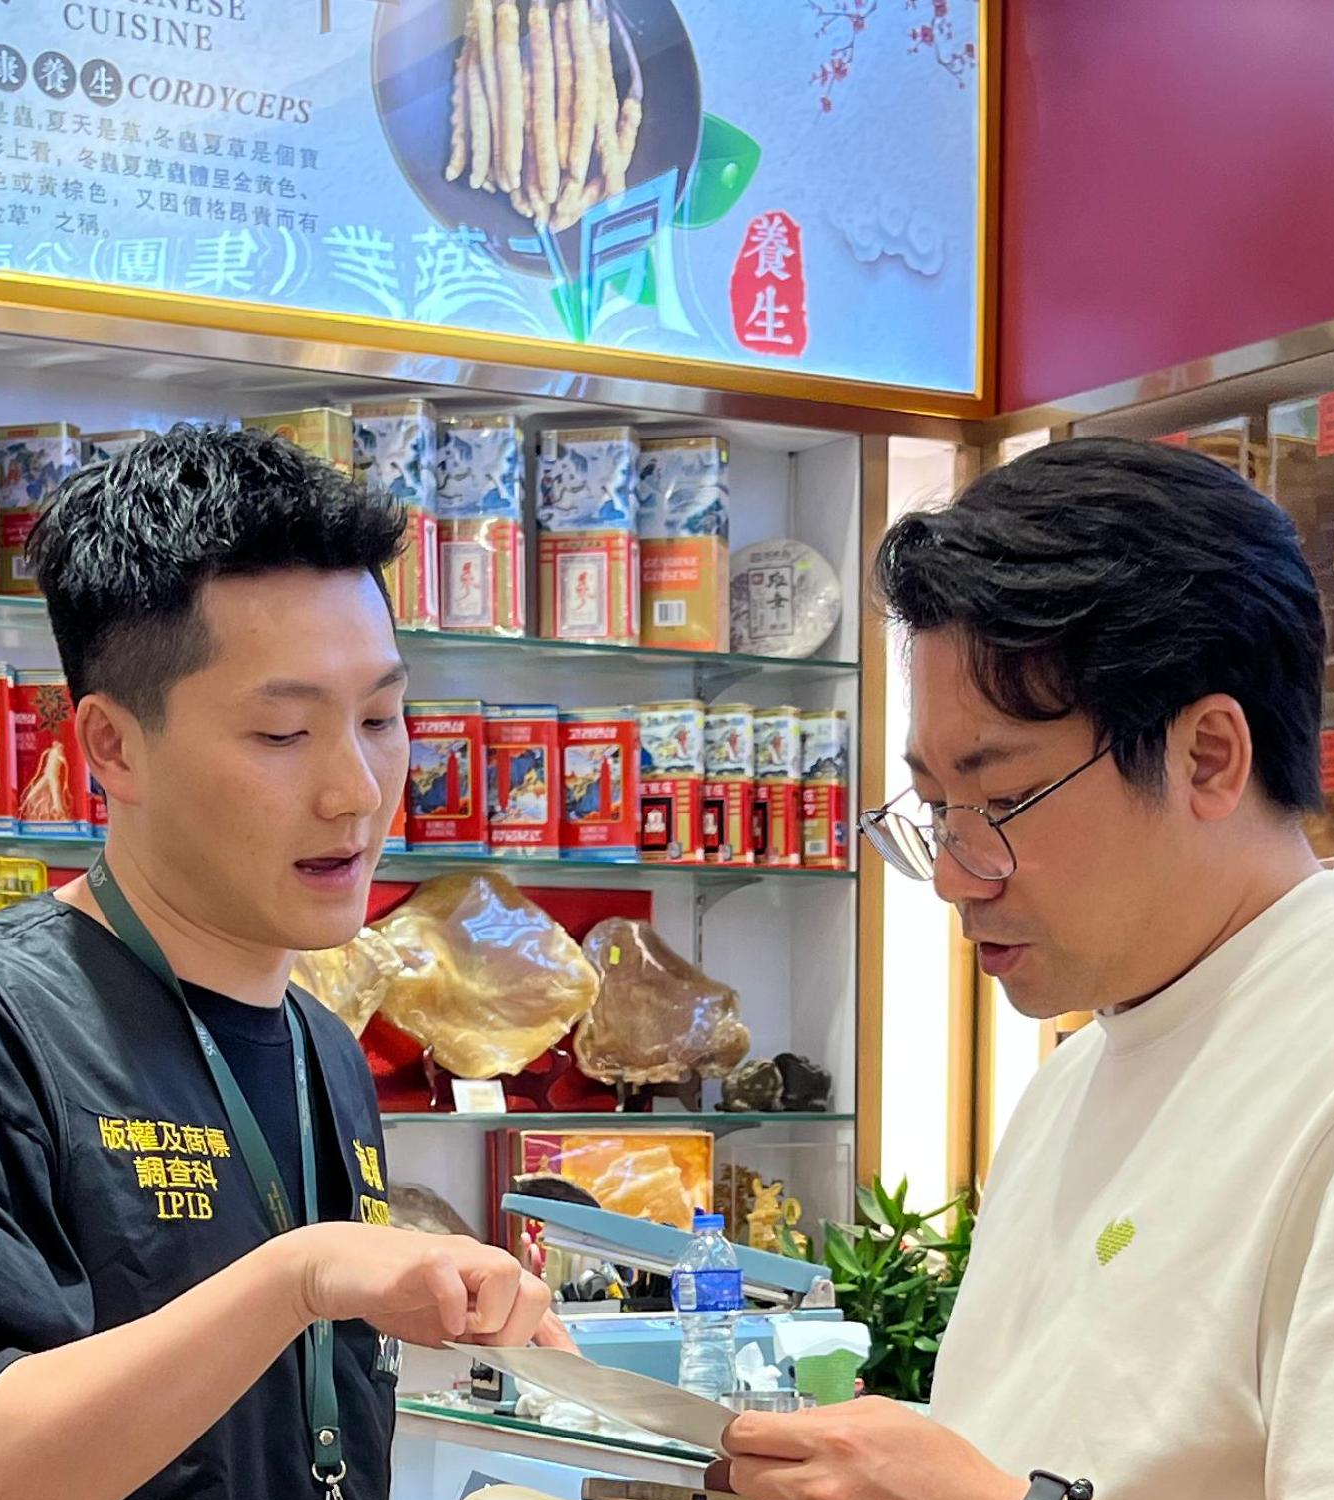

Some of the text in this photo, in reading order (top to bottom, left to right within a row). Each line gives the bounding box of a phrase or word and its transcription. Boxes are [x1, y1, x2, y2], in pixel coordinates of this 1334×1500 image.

[63, 4, 214, 52] CUISINE
[127, 73, 312, 125] CORDYCEPS
[743, 216, 795, 347] 養生
[98, 1116, 230, 1158] 版權及商標
[133, 1156, 218, 1191] 調查科
[154, 1191, 213, 1219] IPIB
